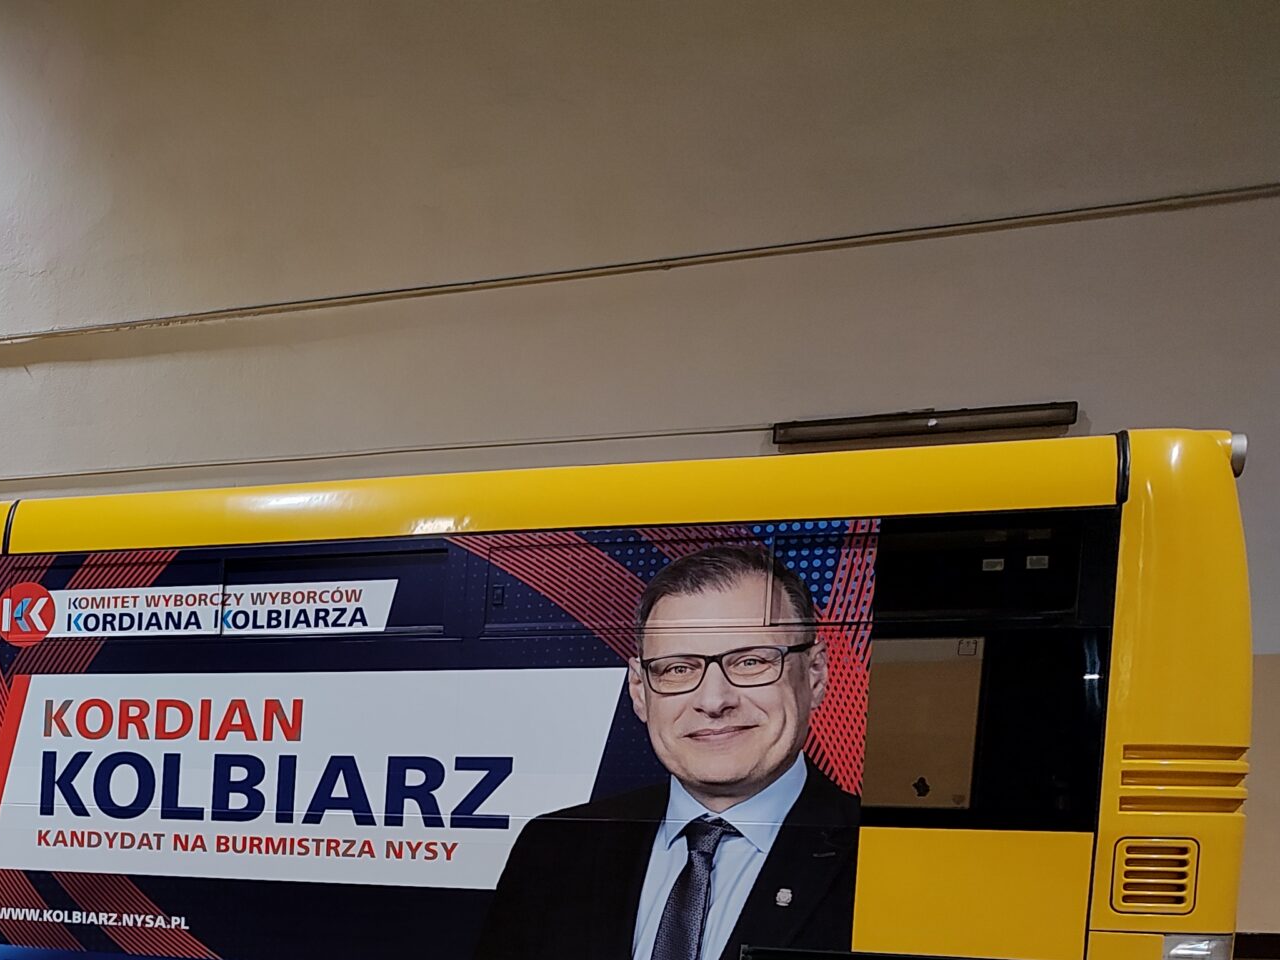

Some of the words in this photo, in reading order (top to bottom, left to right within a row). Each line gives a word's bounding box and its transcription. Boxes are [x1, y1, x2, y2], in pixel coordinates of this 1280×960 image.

[68, 595, 140, 610] KOMITET
[145, 592, 244, 608] WYBORCZY
[251, 586, 363, 606] WYBORCÓW
[67, 610, 202, 632] KORDIANA
[213, 606, 368, 630] KOLBIARZA
[42, 698, 304, 742] KORDIAN
[38, 750, 514, 830] KOLBIARZ
[36, 829, 165, 851] KANDYDAT
[172, 833, 208, 853] NA
[215, 834, 376, 859] BURMISTRZA
[384, 840, 459, 861] NYSY
